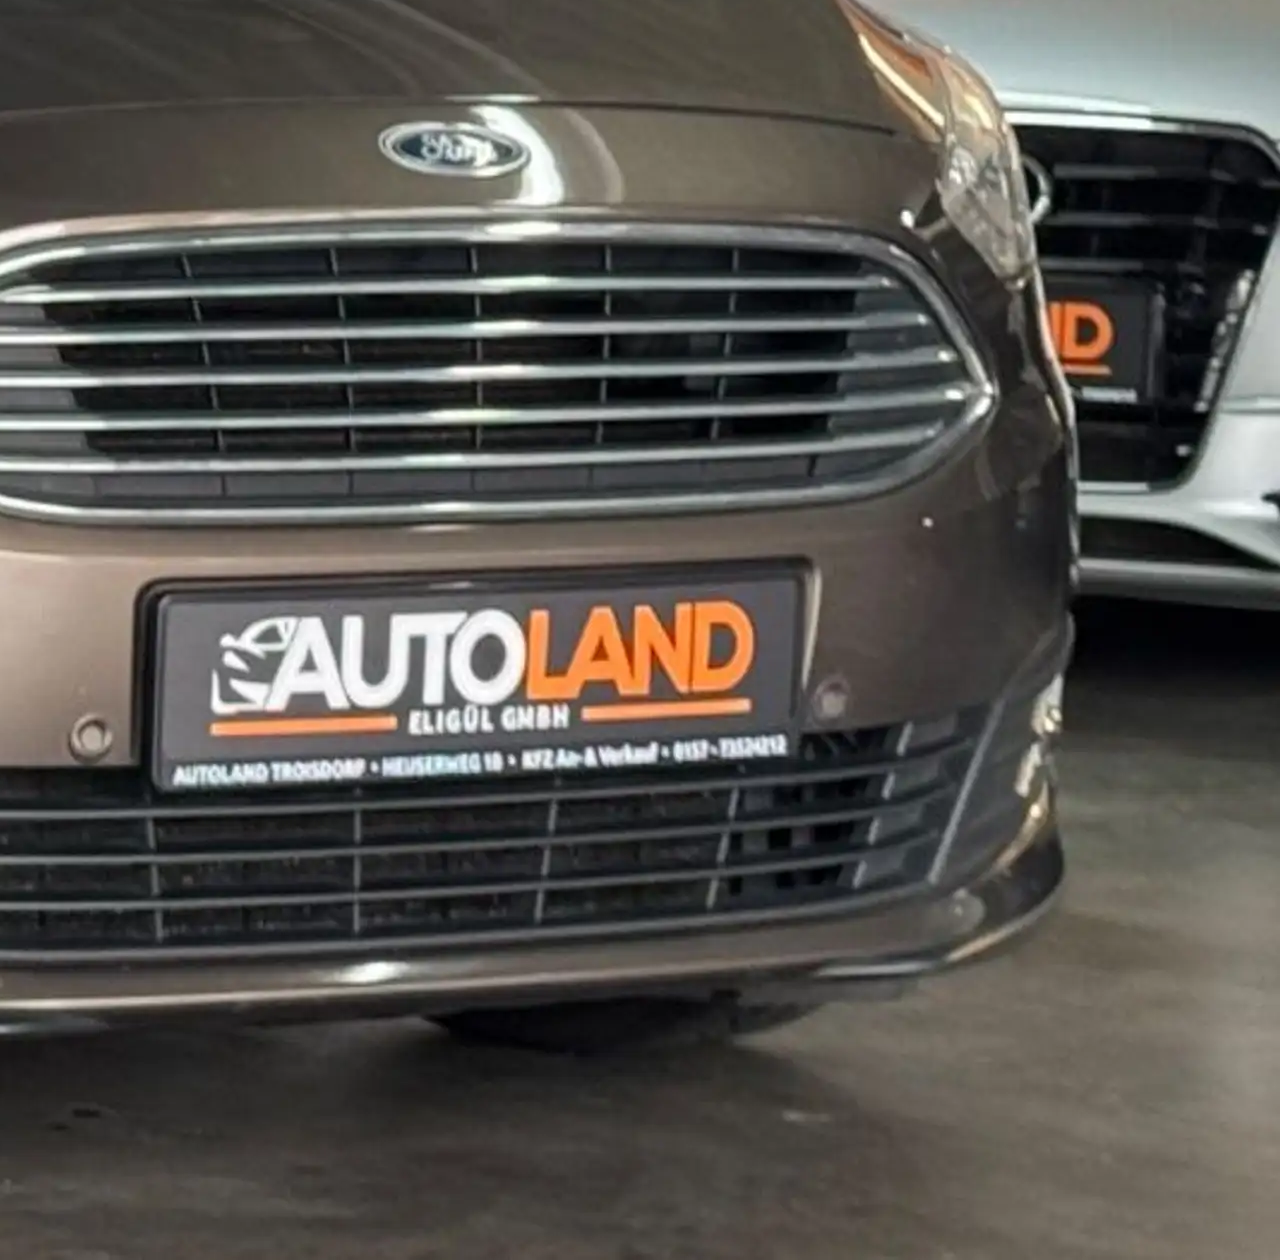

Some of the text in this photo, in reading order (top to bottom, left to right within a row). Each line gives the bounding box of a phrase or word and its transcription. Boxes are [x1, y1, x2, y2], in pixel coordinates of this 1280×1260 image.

[265, 600, 754, 711] AUTOLAND
[172, 761, 270, 786] AUTOLAND
[270, 756, 366, 782] TROISDORF
